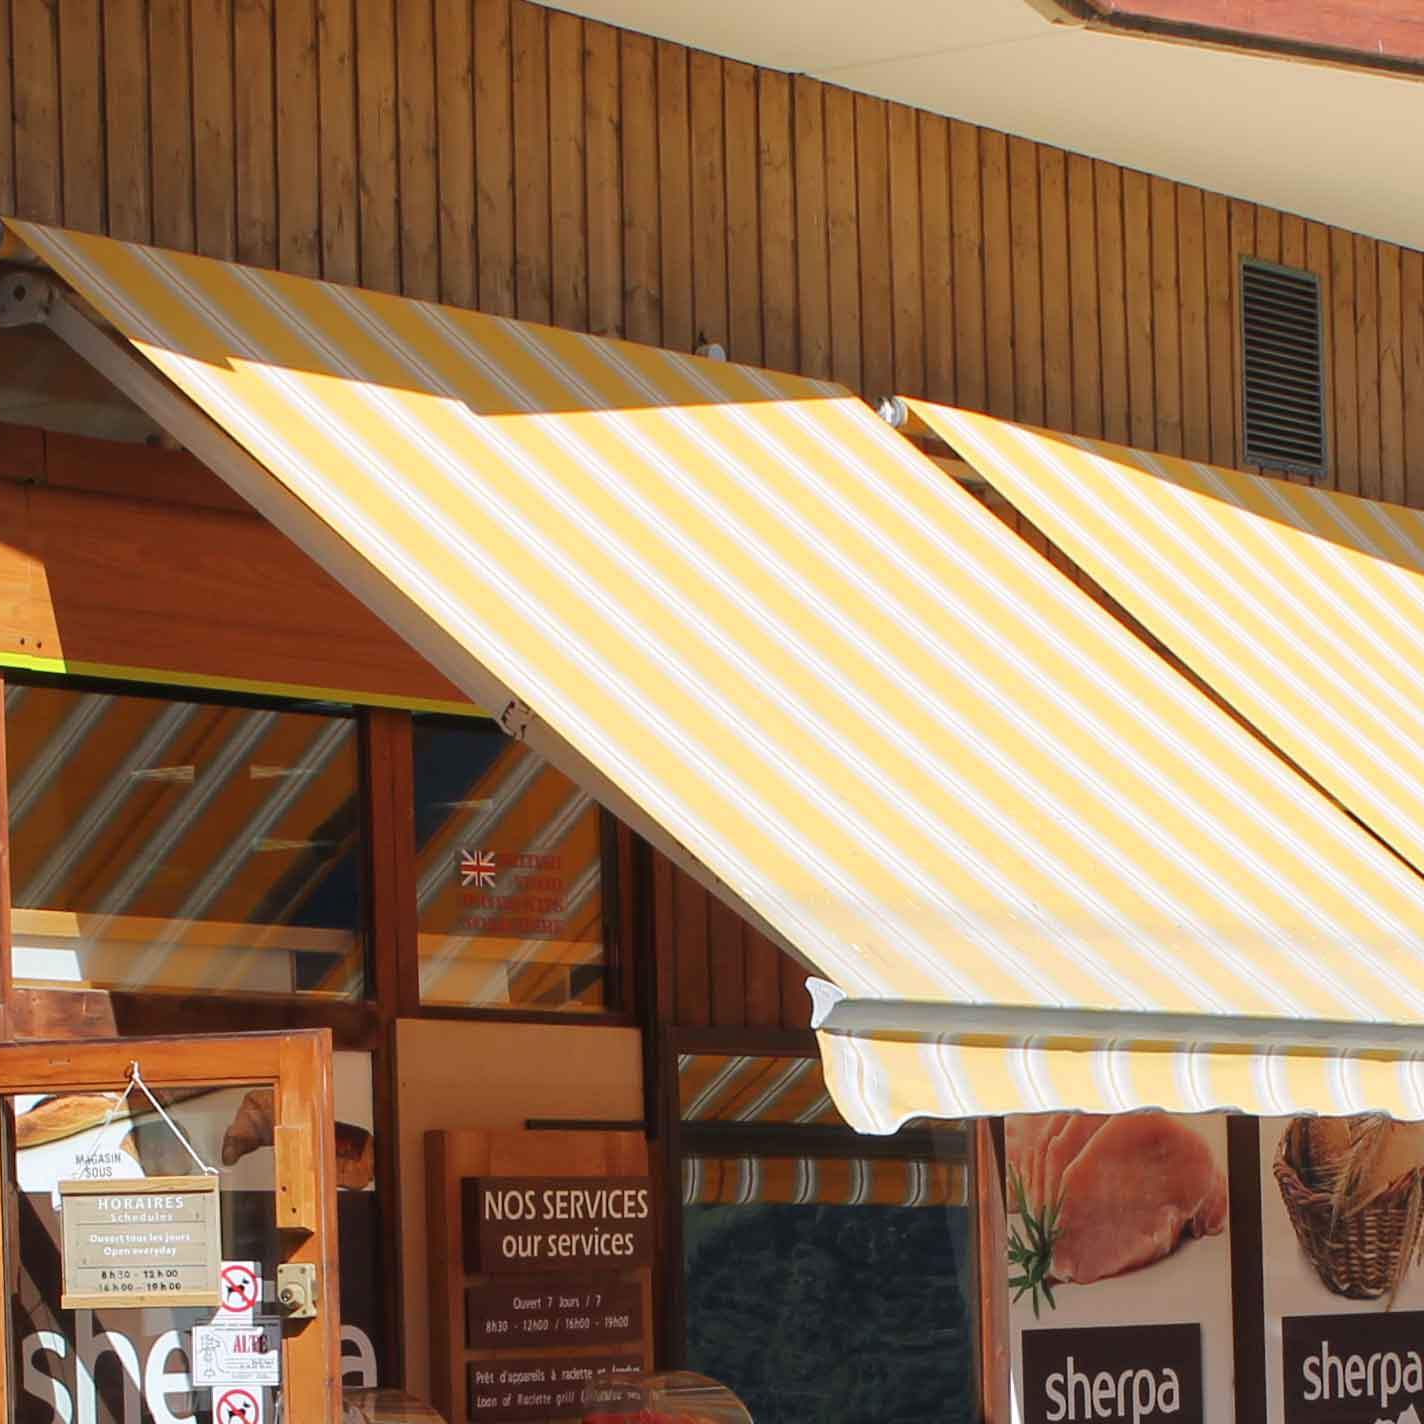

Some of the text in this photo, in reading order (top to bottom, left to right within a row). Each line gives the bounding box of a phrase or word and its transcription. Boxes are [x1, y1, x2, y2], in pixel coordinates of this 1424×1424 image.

[76, 1152, 122, 1165] MAGASIN
[85, 1166, 113, 1178] SOUS
[97, 1196, 184, 1211] HORAIRES
[484, 1188, 649, 1221] NOS SERVICES
[501, 1226, 635, 1258] our services
[103, 1247, 130, 1257] Open
[513, 1297, 542, 1311] Ouvert
[1302, 1341, 1423, 1408] sherpa
